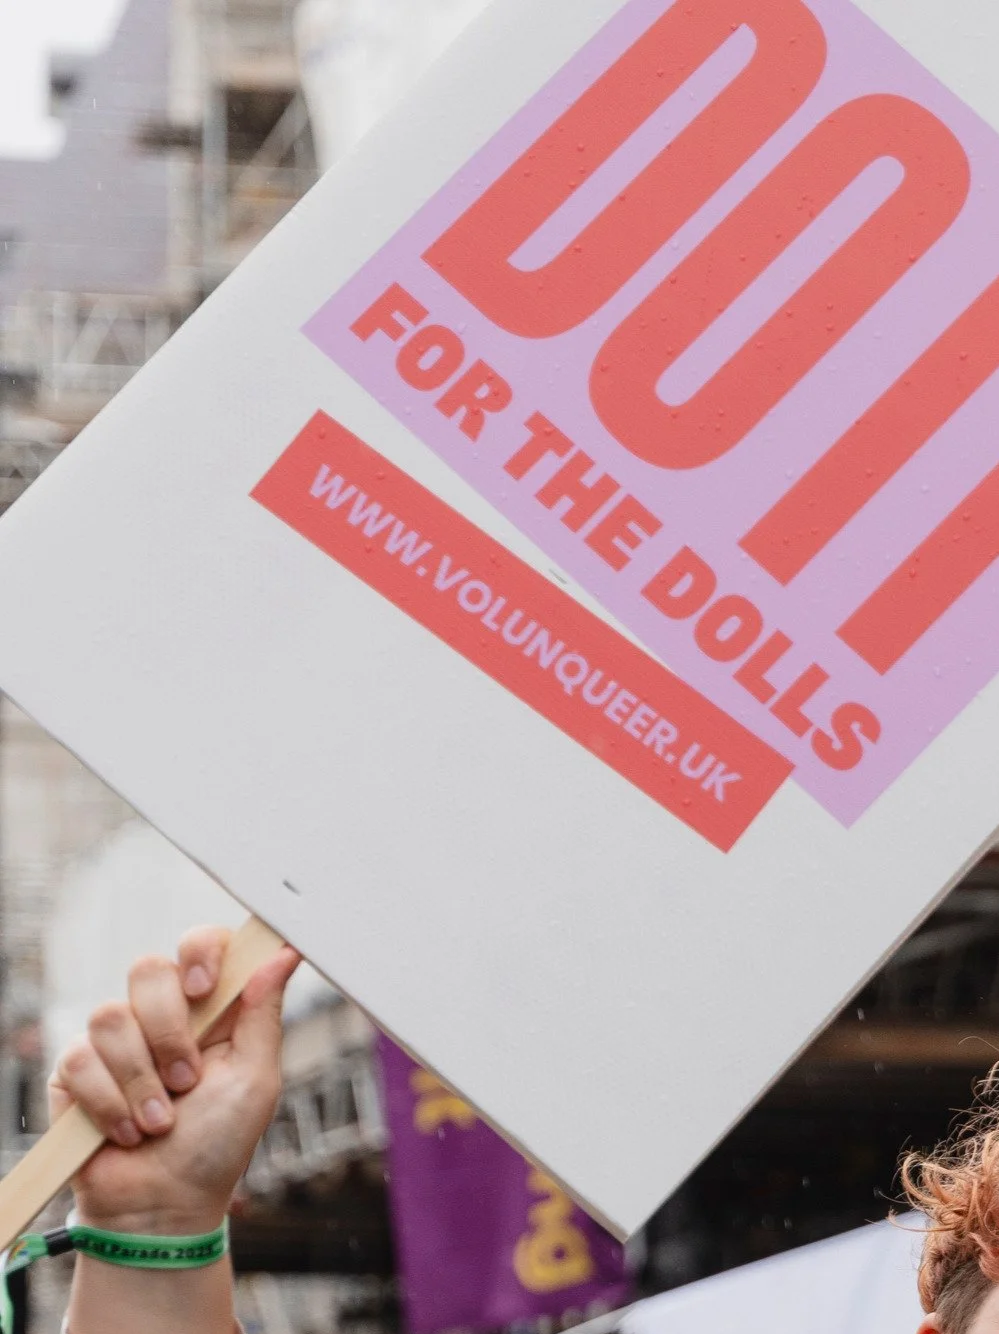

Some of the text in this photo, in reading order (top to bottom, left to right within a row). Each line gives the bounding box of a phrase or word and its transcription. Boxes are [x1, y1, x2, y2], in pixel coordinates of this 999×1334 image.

[421, 0, 971, 470] DO
[310, 464, 742, 802] WWW.VOLUNQUEER.UK
[349, 282, 882, 771] FOR THE DOLLS
